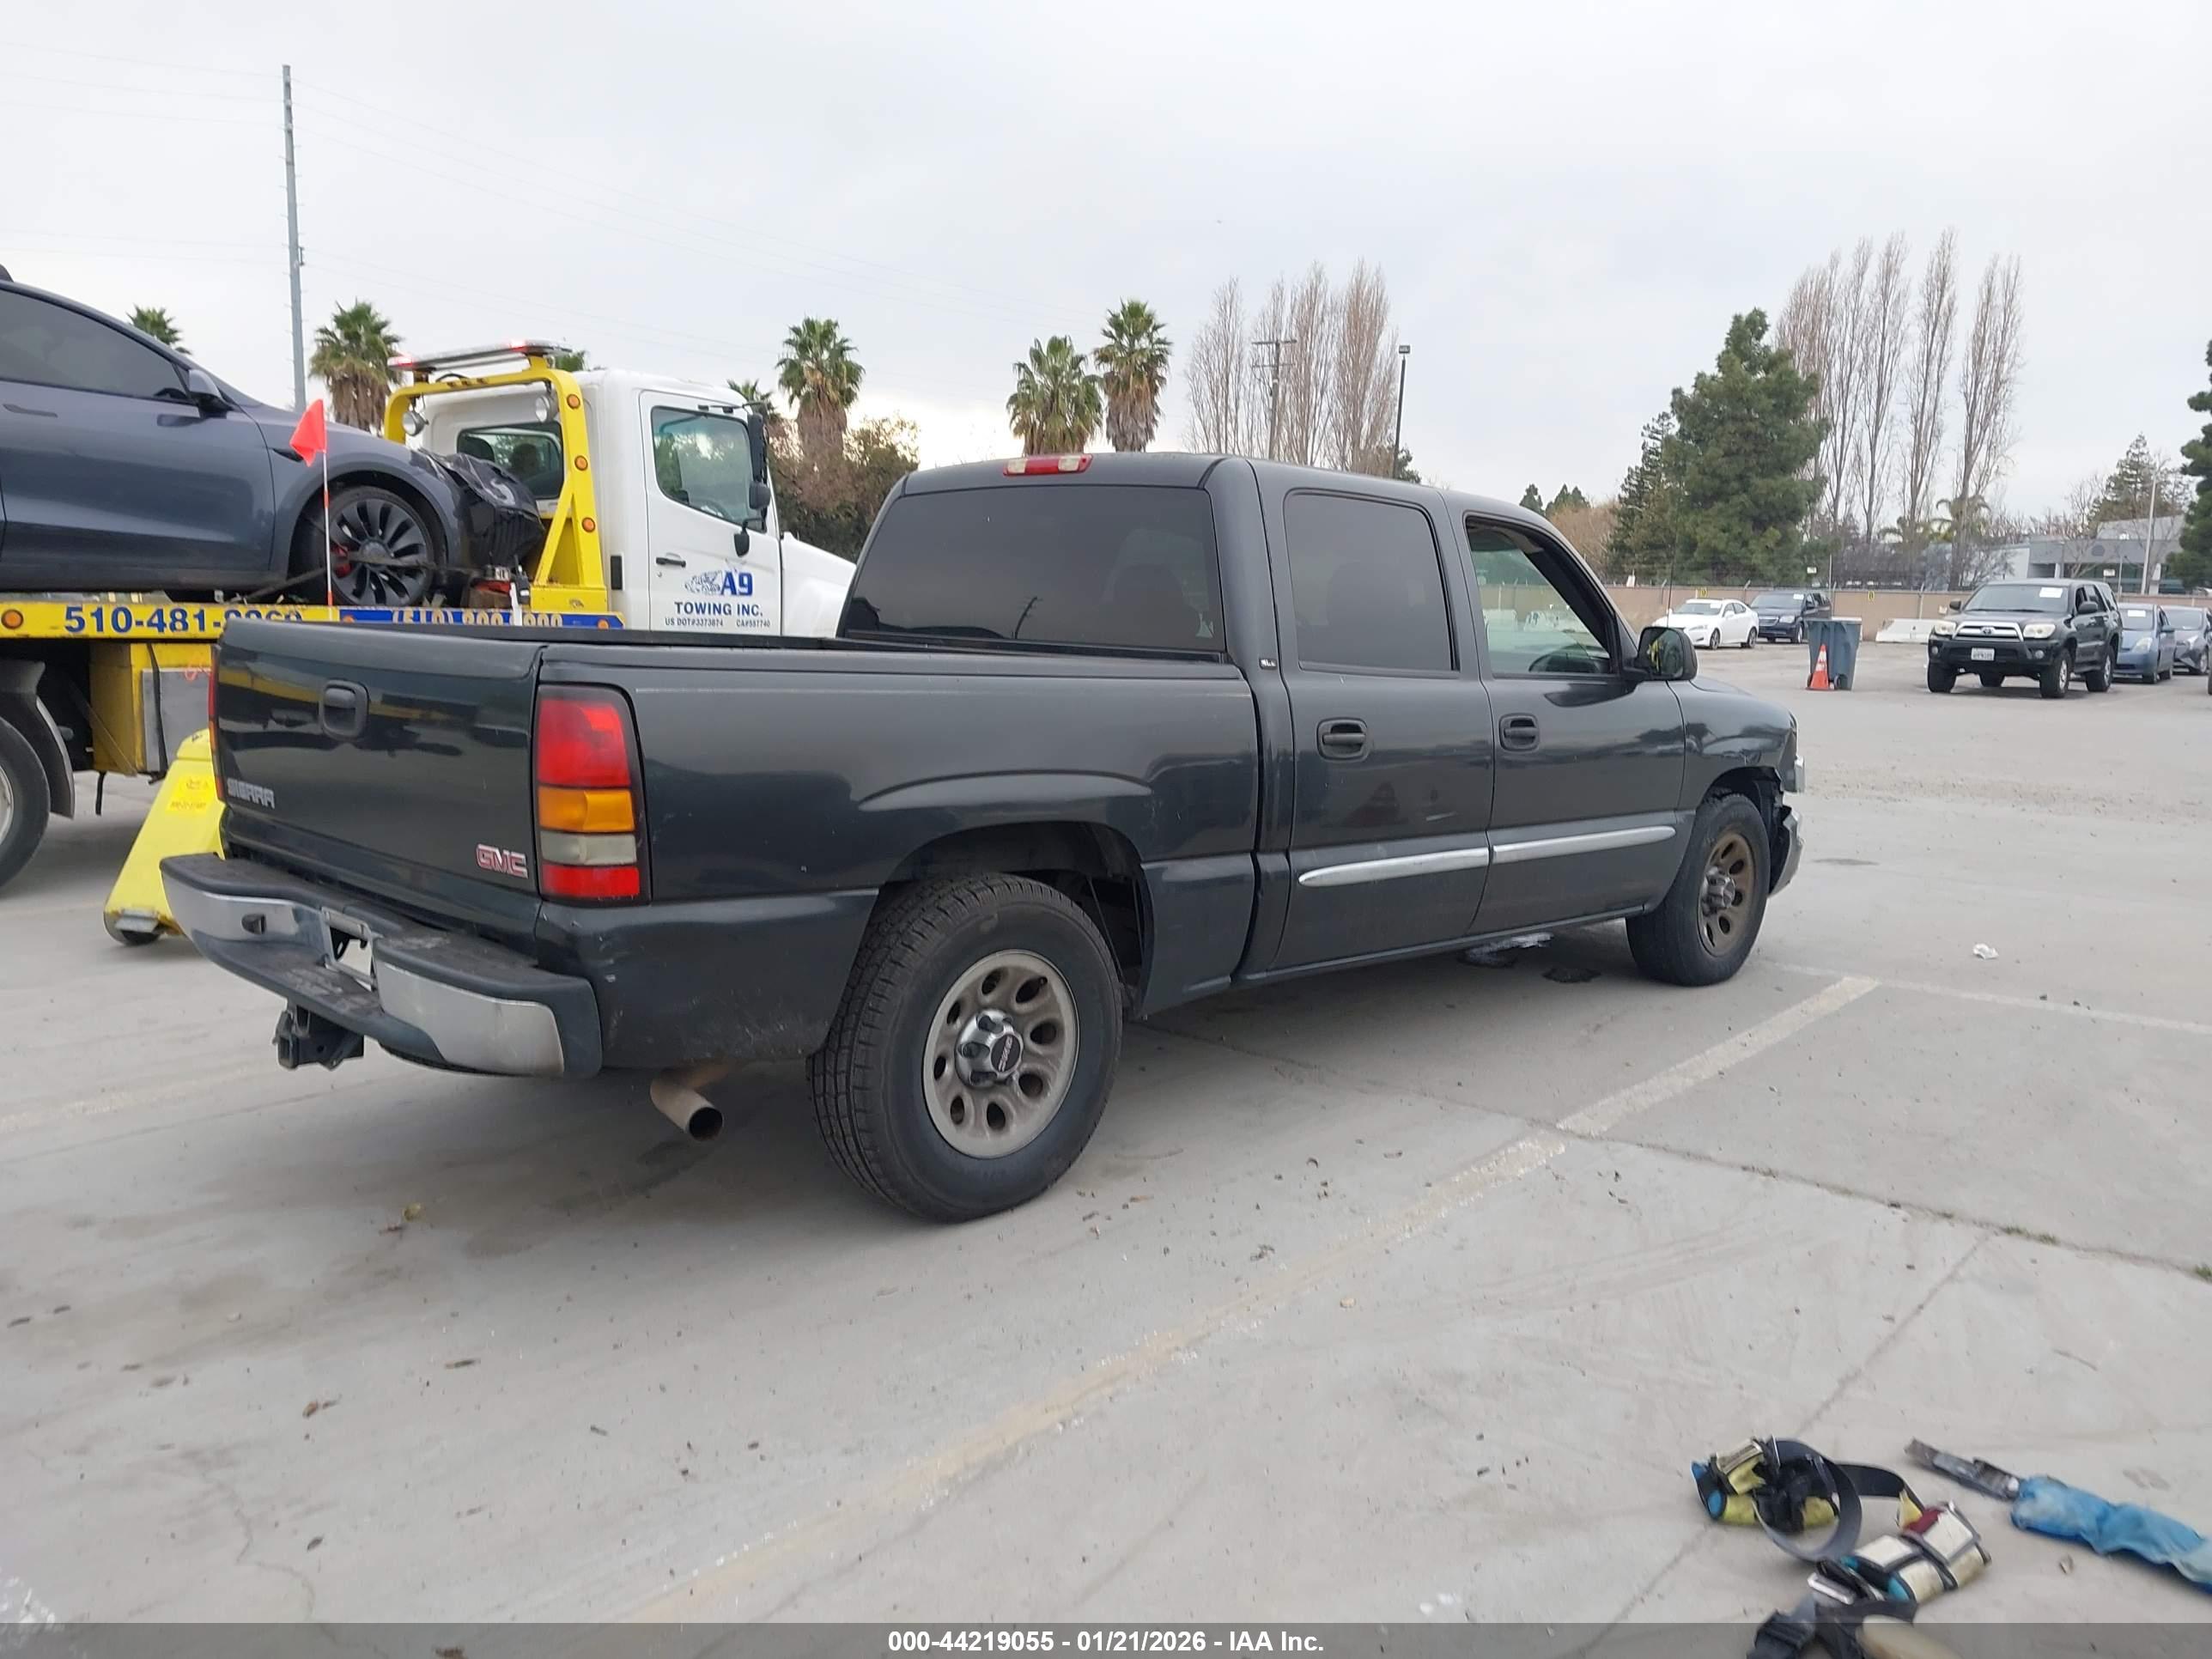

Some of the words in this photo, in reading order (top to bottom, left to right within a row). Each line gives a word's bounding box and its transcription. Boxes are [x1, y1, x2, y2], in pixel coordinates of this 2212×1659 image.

[720, 570, 753, 596] A9
[665, 617, 675, 626] US
[674, 601, 732, 616] TOWING
[737, 604, 763, 617] INC.
[227, 777, 275, 809] SIERRA
[476, 843, 529, 879] GMC
